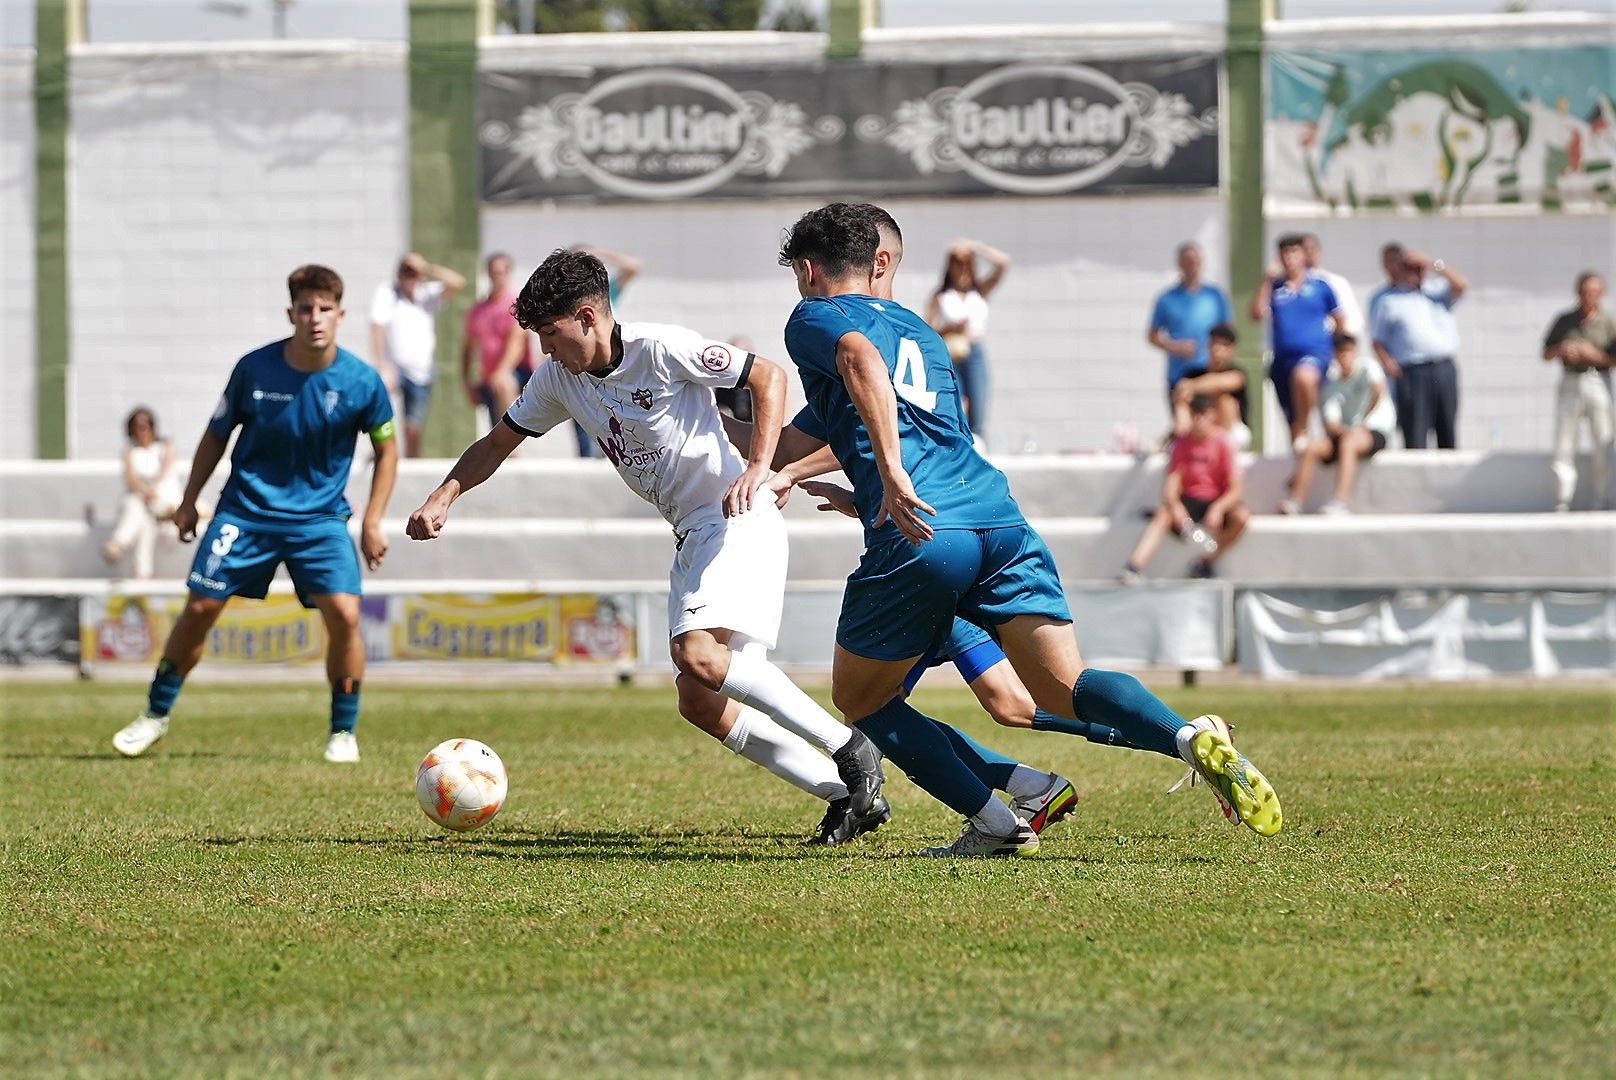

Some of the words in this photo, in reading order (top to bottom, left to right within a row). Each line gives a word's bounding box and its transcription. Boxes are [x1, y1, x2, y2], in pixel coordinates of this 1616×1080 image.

[580, 104, 744, 152] Gaultier
[956, 97, 1127, 148] Gaultier
[893, 337, 938, 414] 4
[211, 523, 240, 557] 3
[210, 619, 306, 656] sterra
[407, 609, 544, 656] Casterra
